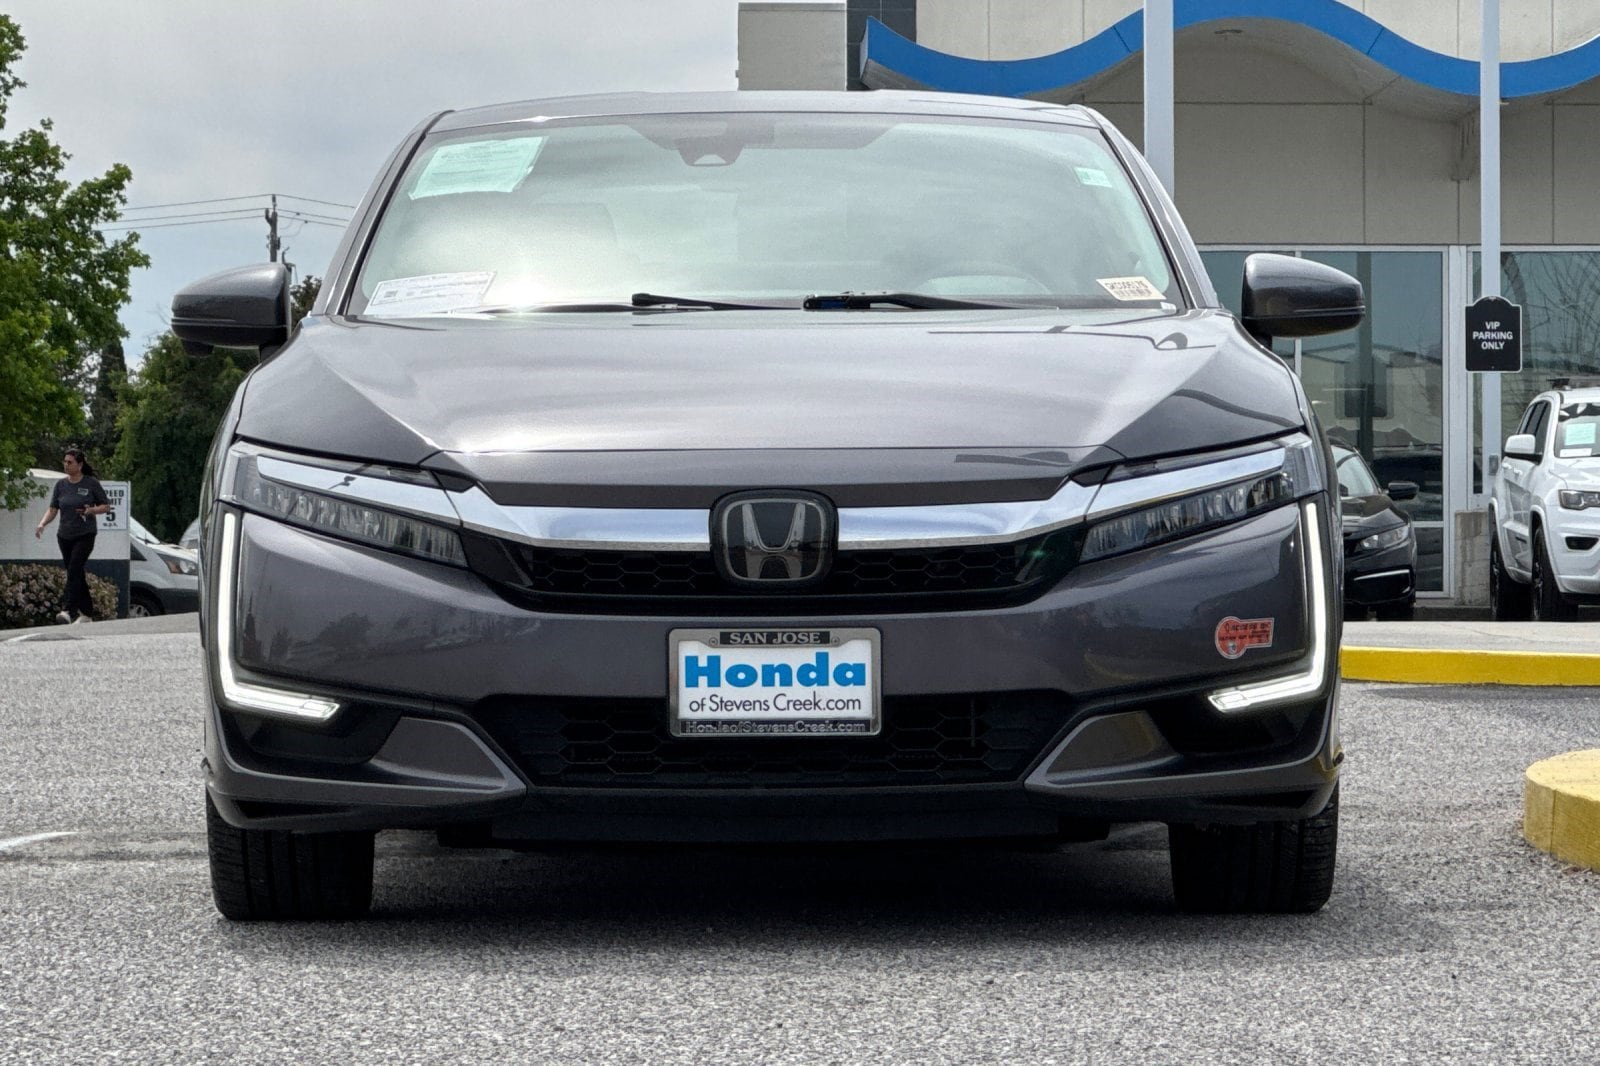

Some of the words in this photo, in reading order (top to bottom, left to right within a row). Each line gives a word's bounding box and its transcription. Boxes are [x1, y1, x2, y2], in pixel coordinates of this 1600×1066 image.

[1485, 321, 1500, 330] VIP
[1472, 331, 1513, 340] PARKING
[1481, 341, 1505, 350] ONLY
[729, 632, 767, 644] SAN
[772, 632, 821, 644] JOSE
[684, 652, 866, 688] Honda
[689, 697, 706, 712] of
[709, 694, 770, 712] Stevens
[773, 691, 861, 711] Creek.com
